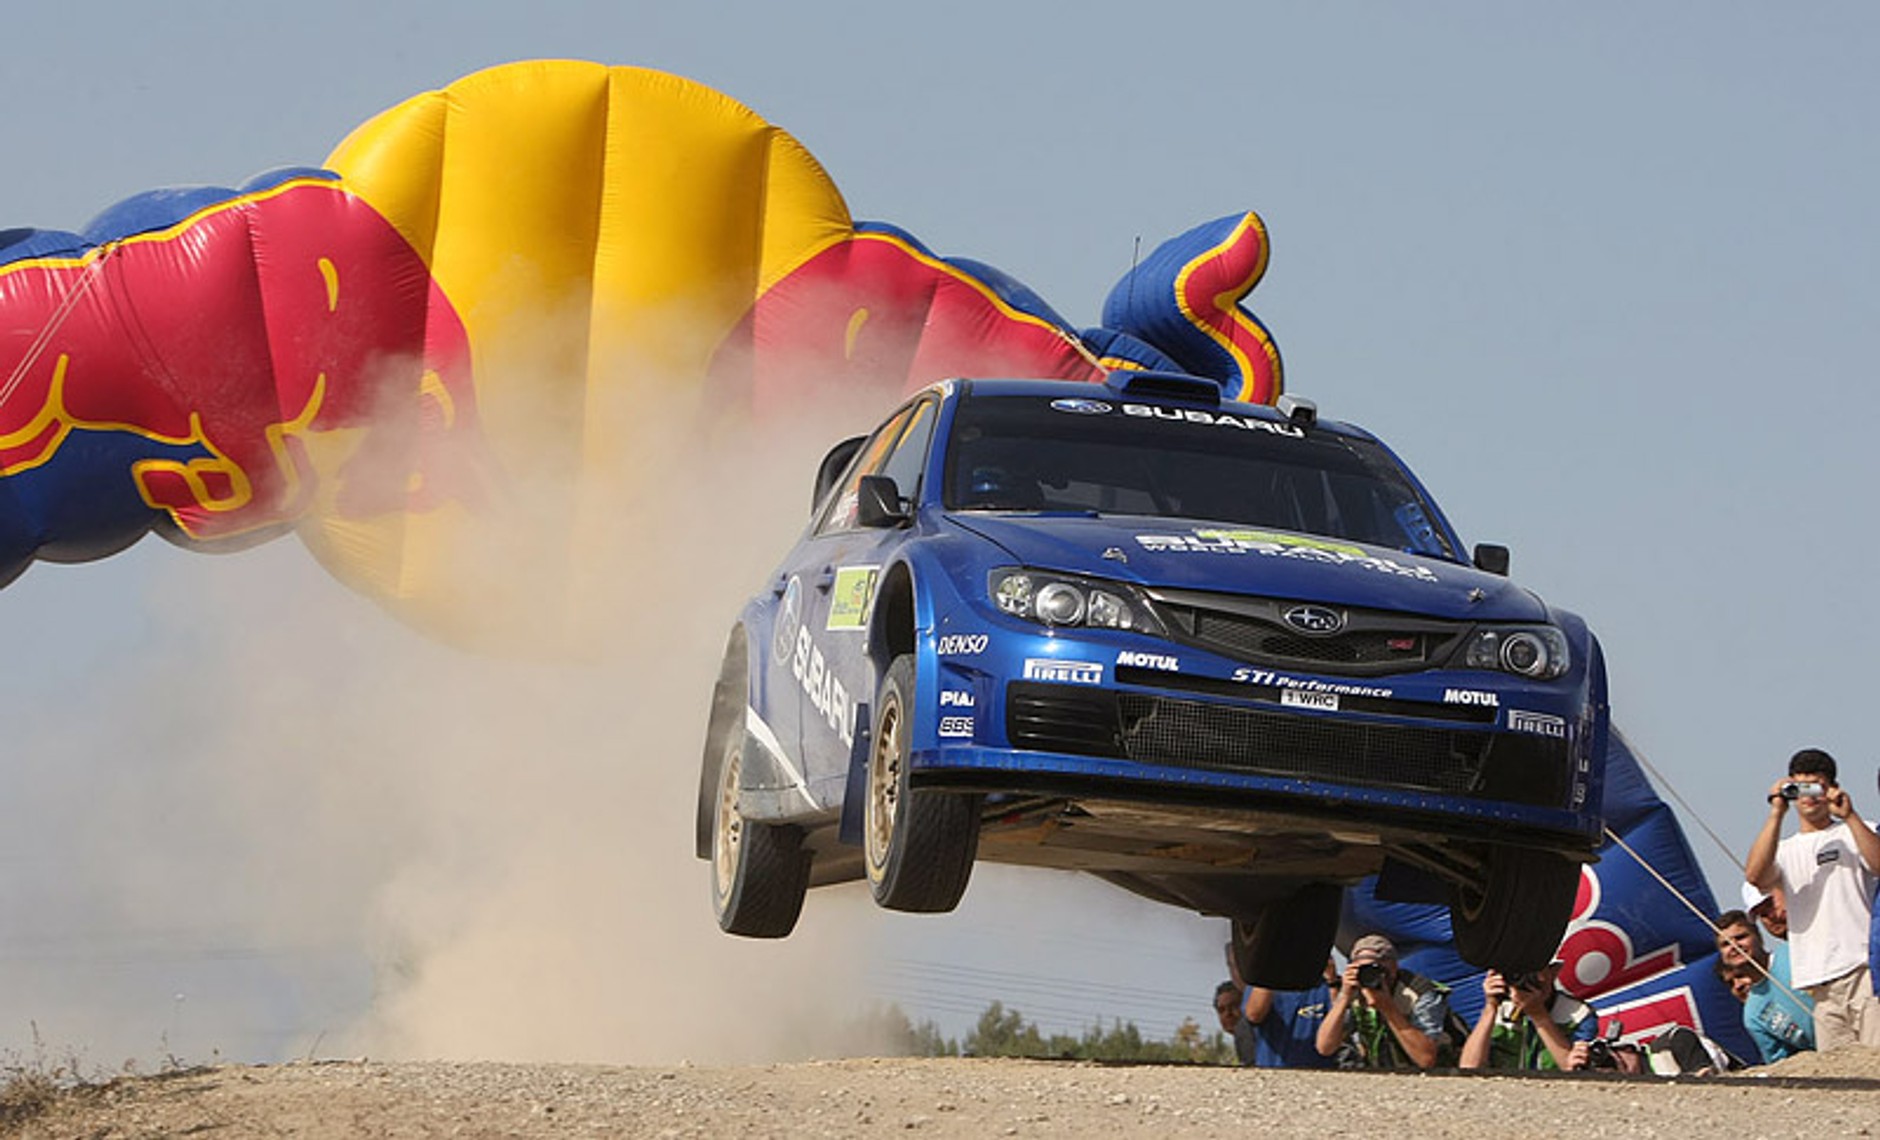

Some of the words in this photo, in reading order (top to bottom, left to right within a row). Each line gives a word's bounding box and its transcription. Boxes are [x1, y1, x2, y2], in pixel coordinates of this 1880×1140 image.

[1122, 403, 1305, 438] SUBARU
[938, 635, 989, 655] DENSO
[1023, 658, 1104, 684] PIRELLI
[1116, 651, 1179, 671] MOTUL
[793, 624, 859, 750] SUBARU
[1231, 668, 1276, 686] STI
[1276, 677, 1393, 698] Performance
[940, 691, 975, 707] PIA
[1299, 692, 1335, 708] WRC
[1444, 688, 1499, 707] MOTUL
[1508, 709, 1566, 738] PIRELLI
